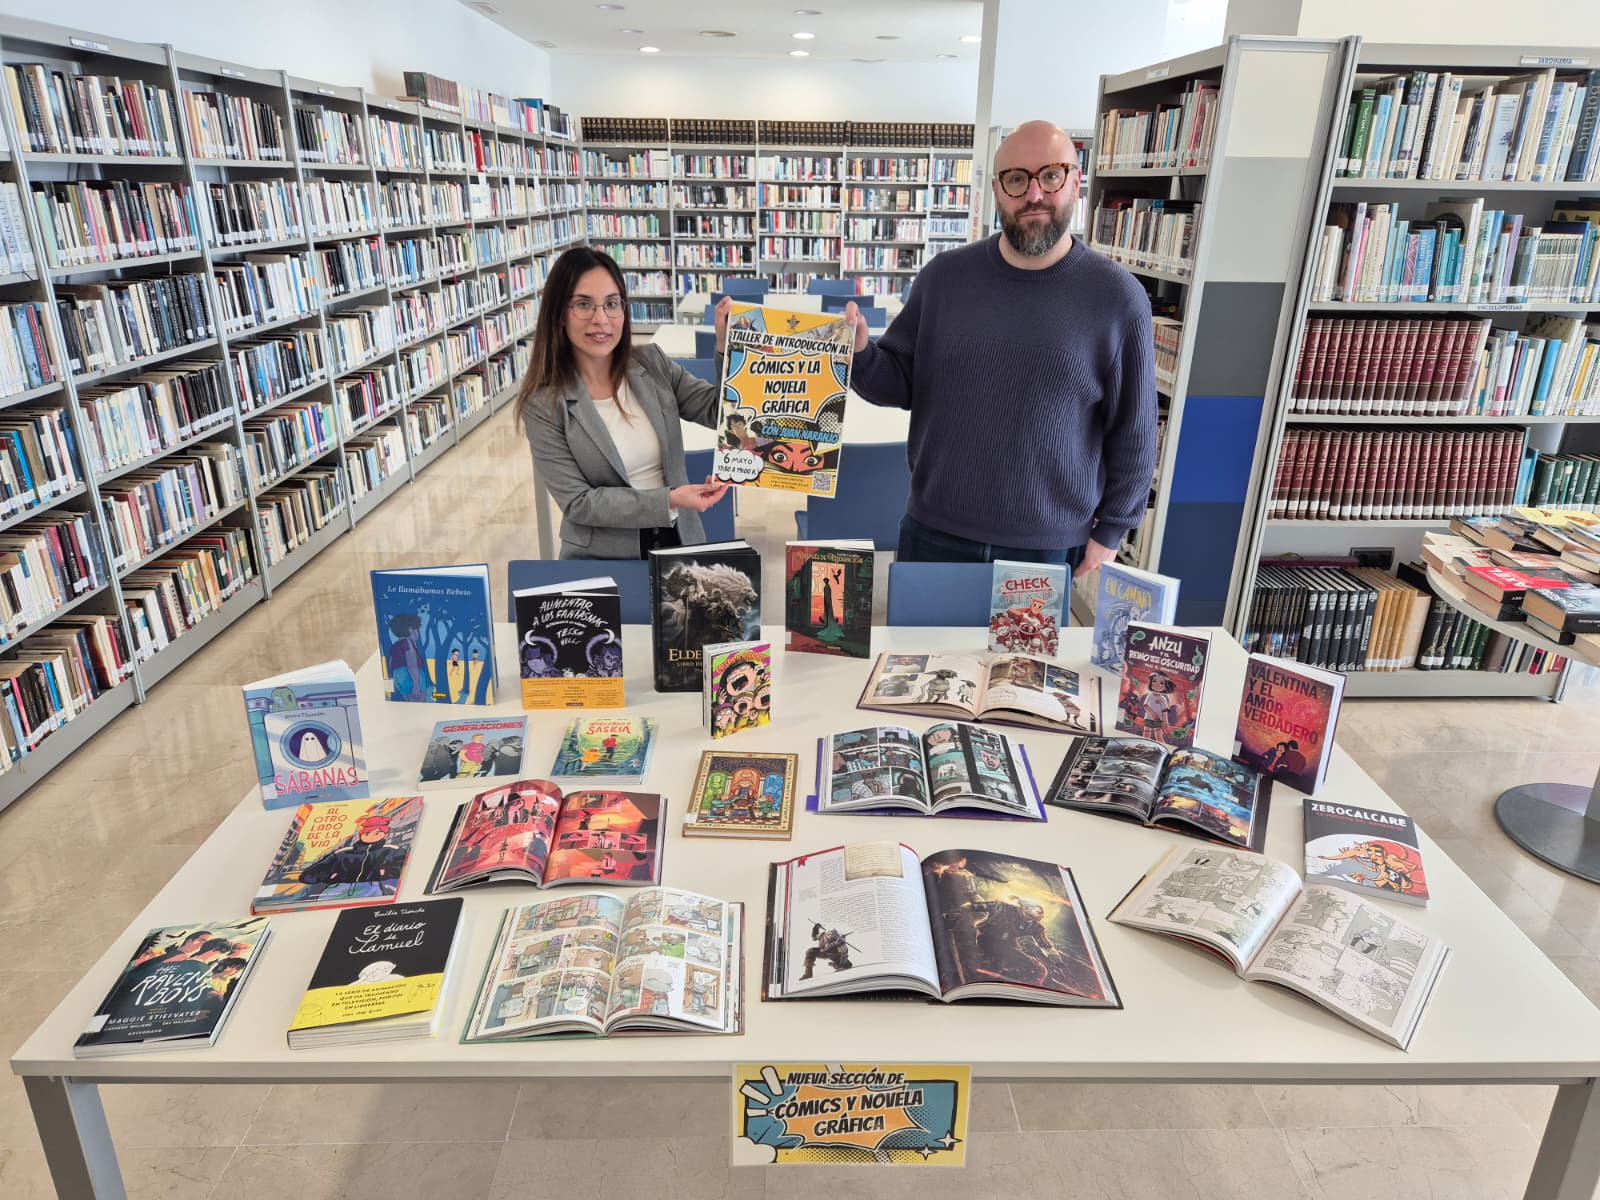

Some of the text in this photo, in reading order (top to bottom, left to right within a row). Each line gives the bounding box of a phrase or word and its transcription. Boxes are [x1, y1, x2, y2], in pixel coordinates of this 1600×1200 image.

[1576, 85, 1600, 152] Botánica
[731, 330, 849, 355] TALLER DE INTRODUCCIÓN AL
[749, 354, 820, 374] CÓMICS Y LA
[764, 380, 806, 394] NOVELA
[761, 394, 809, 414] GRÁFICA
[761, 424, 839, 443] CON JUAN NARANJO
[723, 452, 752, 465] 6 MAYO
[1005, 577, 1051, 591] CHECK
[541, 611, 554, 623] LOS
[668, 648, 703, 661] ELDE
[1148, 636, 1183, 657] ANZU
[1160, 658, 1200, 674] OSCURIDAD
[1248, 678, 1275, 698] Y EL
[1251, 663, 1318, 699] VALENTINA
[1245, 692, 1284, 716] AMOR
[442, 721, 523, 733] GENERACIONES
[586, 724, 632, 736] SASKIA
[1244, 705, 1318, 745] VERDADERO
[274, 766, 359, 796] SÁBANAS
[313, 814, 348, 823] OTRO
[327, 807, 339, 815] AL
[1311, 803, 1407, 827] ZEROCALCARE
[306, 831, 340, 840] DE LA
[310, 822, 343, 831] LADO
[363, 921, 426, 935] El diario
[348, 930, 425, 954] Samuel
[154, 965, 181, 975] THE
[131, 962, 219, 1006] RAVEN
[144, 981, 211, 1006] BOYS
[107, 1016, 145, 1024] MAGGIE
[148, 1010, 201, 1021] STIEFVATER
[786, 1068, 904, 1085] NUEVA SECCIÓN DE
[774, 1090, 923, 1120] CÓMICS Y NOVELA
[813, 1113, 884, 1137] GRÁFICA
